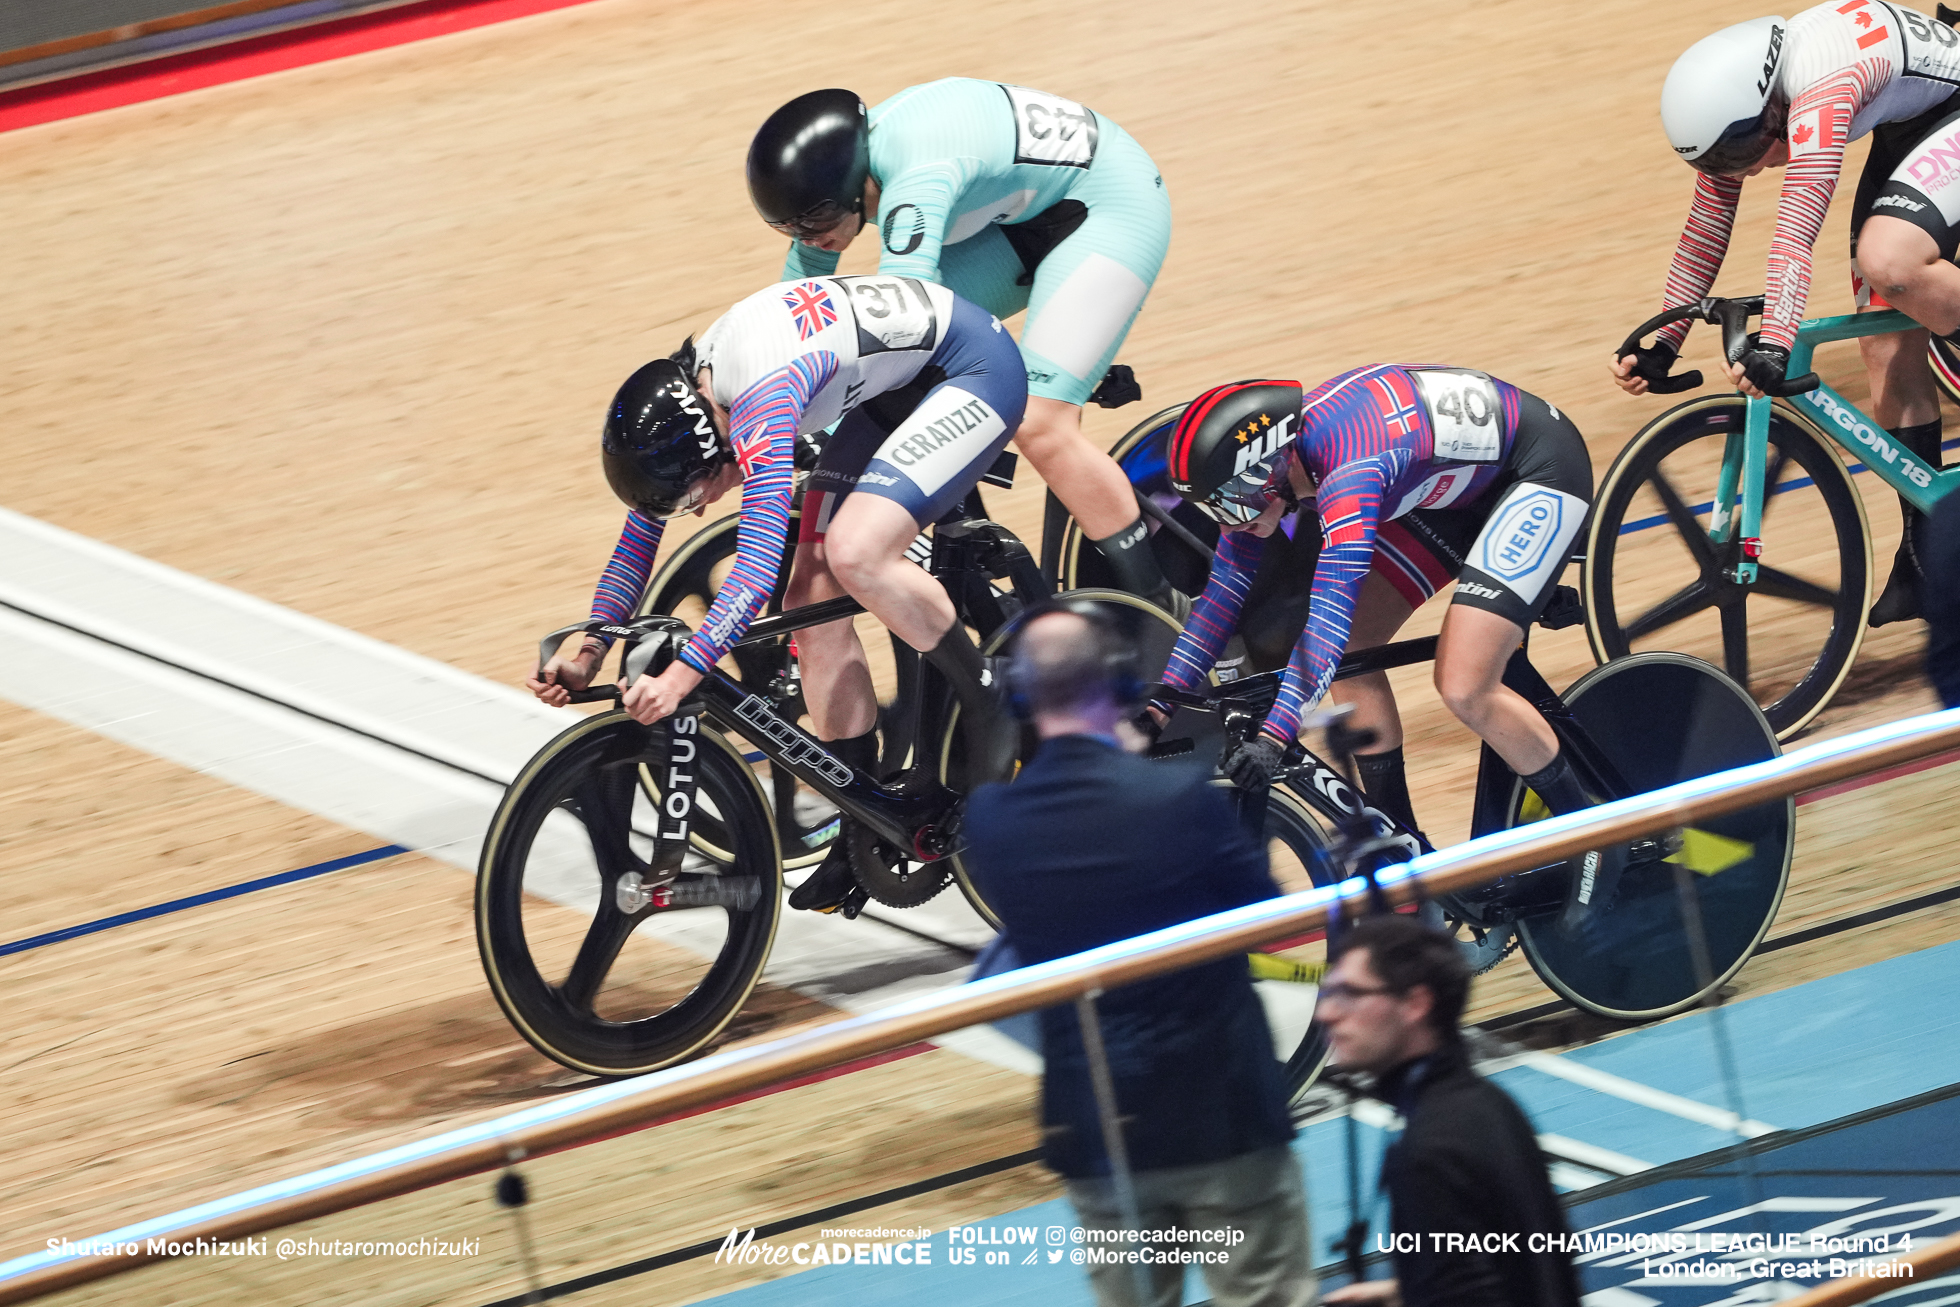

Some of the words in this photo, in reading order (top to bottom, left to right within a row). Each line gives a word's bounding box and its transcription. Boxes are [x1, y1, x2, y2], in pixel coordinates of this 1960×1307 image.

[1900, 9, 1958, 48] 50
[1757, 24, 1785, 98] LAZER
[855, 284, 908, 319] 37
[1772, 256, 1801, 327] Santini
[891, 399, 990, 467] CERATIZIT
[1436, 386, 1489, 427] 40
[1233, 413, 1297, 477] HJC
[1900, 457, 1932, 488] 18
[1499, 506, 1549, 565] HERO
[599, 625, 635, 636] LOTUS
[708, 583, 755, 648] Santini
[732, 693, 855, 788] hope
[662, 715, 698, 841] LOTUS
